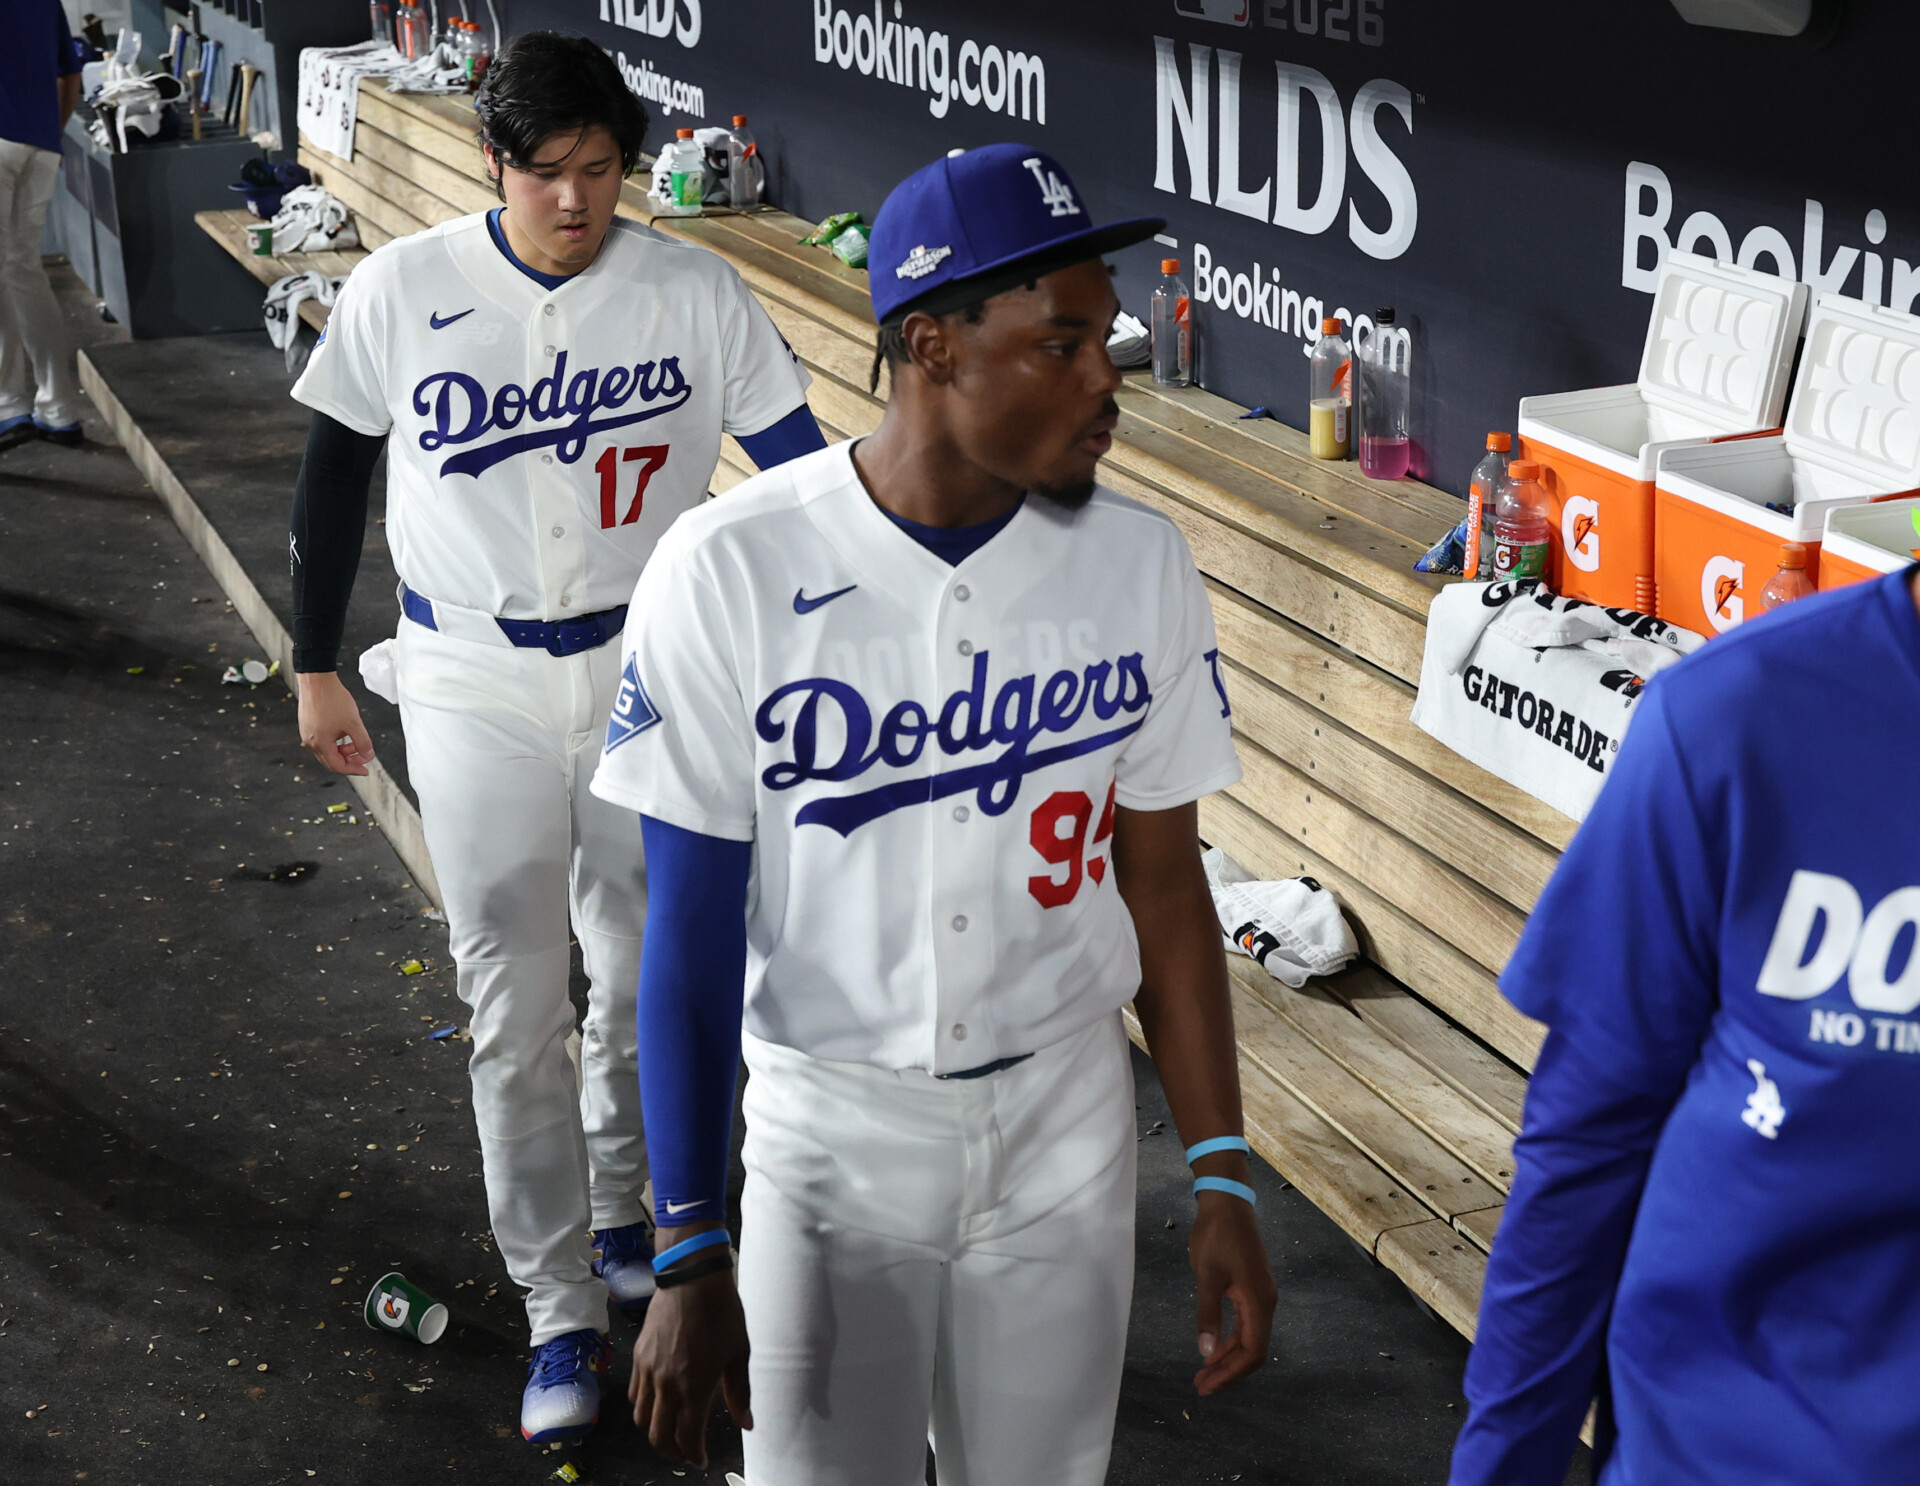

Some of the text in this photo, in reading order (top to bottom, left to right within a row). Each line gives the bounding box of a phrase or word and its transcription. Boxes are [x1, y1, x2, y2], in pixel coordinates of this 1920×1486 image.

[814, 0, 1046, 126] Booking.com
[1263, 0, 1384, 47] 2026
[1022, 157, 1081, 217] LA
[1153, 35, 1418, 260] NLDS
[1621, 160, 1920, 339] Bki
[1194, 242, 1412, 378] Bookingcom
[413, 350, 692, 465] Dodgers
[595, 443, 670, 529] 17
[1561, 495, 1600, 572] G
[825, 618, 1102, 702] DOERS
[755, 650, 1153, 817] Dodgers
[1808, 1008, 1866, 1047] NO
